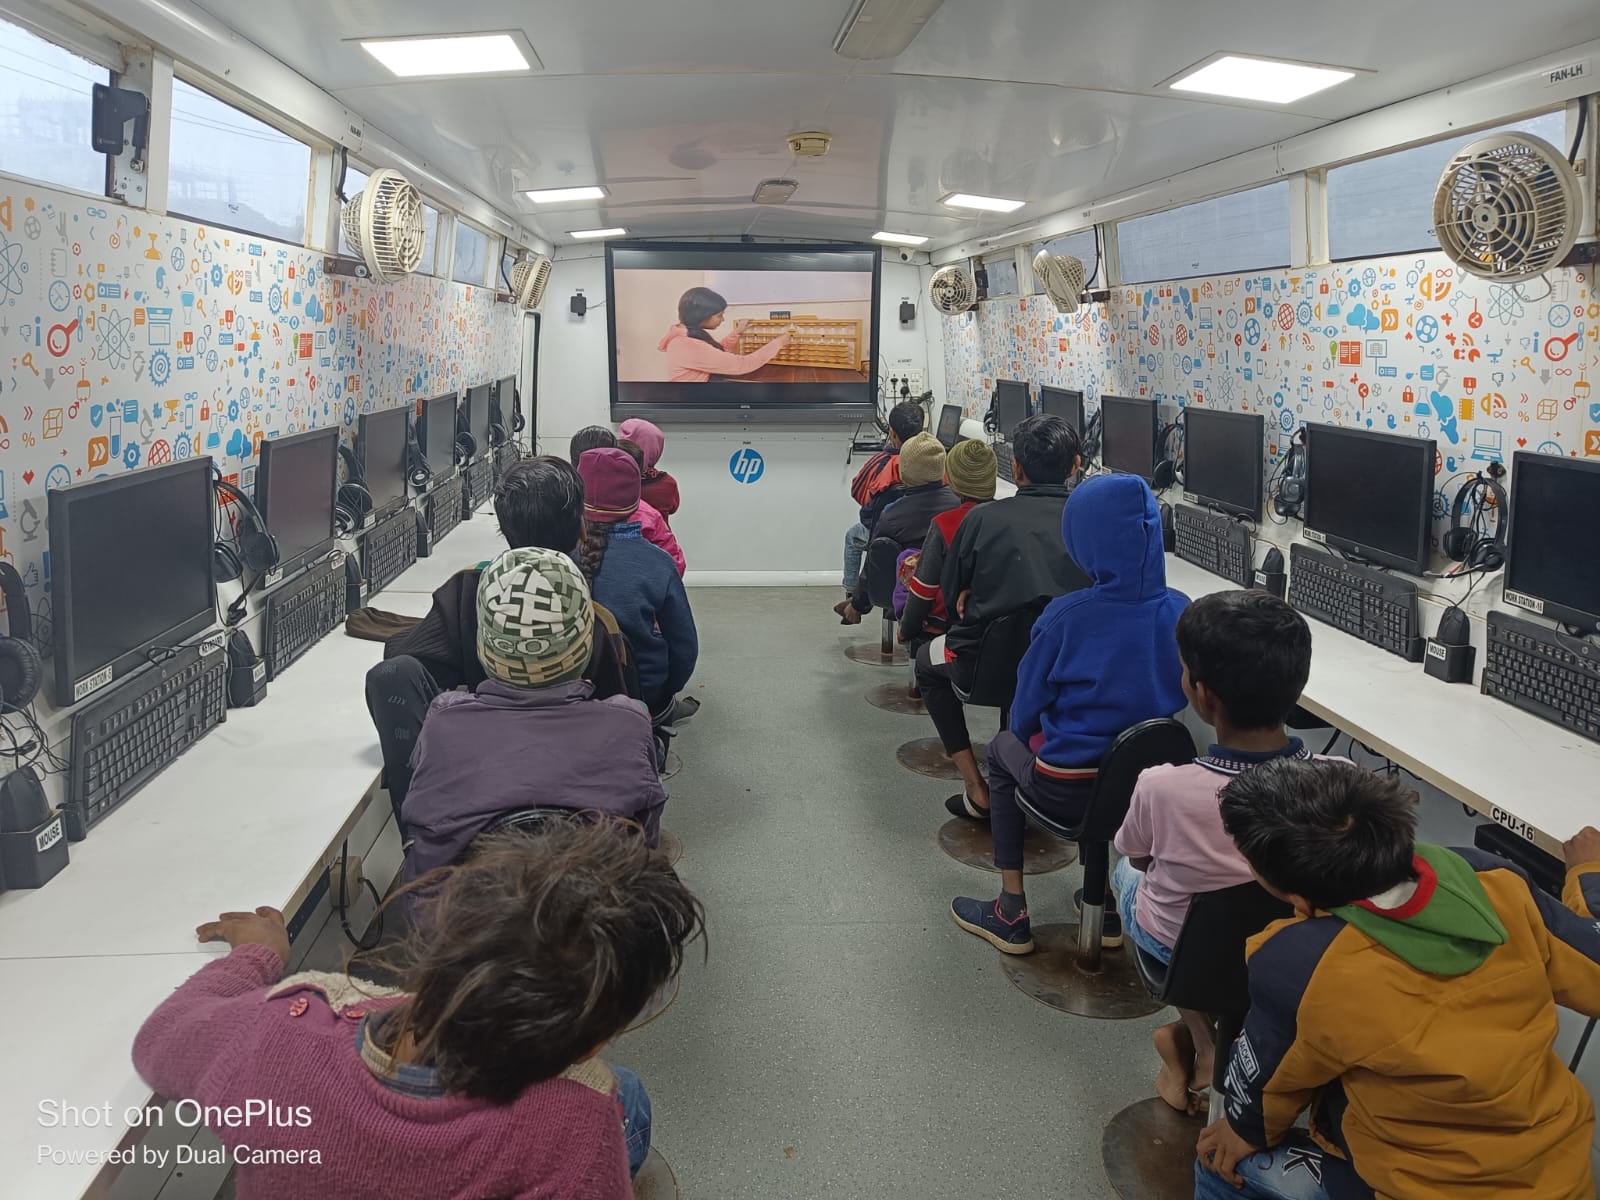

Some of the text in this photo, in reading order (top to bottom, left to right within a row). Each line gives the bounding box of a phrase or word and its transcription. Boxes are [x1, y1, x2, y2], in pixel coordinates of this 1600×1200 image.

[1550, 63, 1583, 83] FAN-LH
[729, 447, 765, 485] hp
[1505, 591, 1517, 602] WORK
[1518, 595, 1535, 609] STATION
[1429, 643, 1446, 658] MOUSE
[75, 680, 89, 698] WORK
[90, 670, 106, 690] STATION
[39, 822, 60, 849] MOUSE
[1492, 807, 1534, 841] CPU-16
